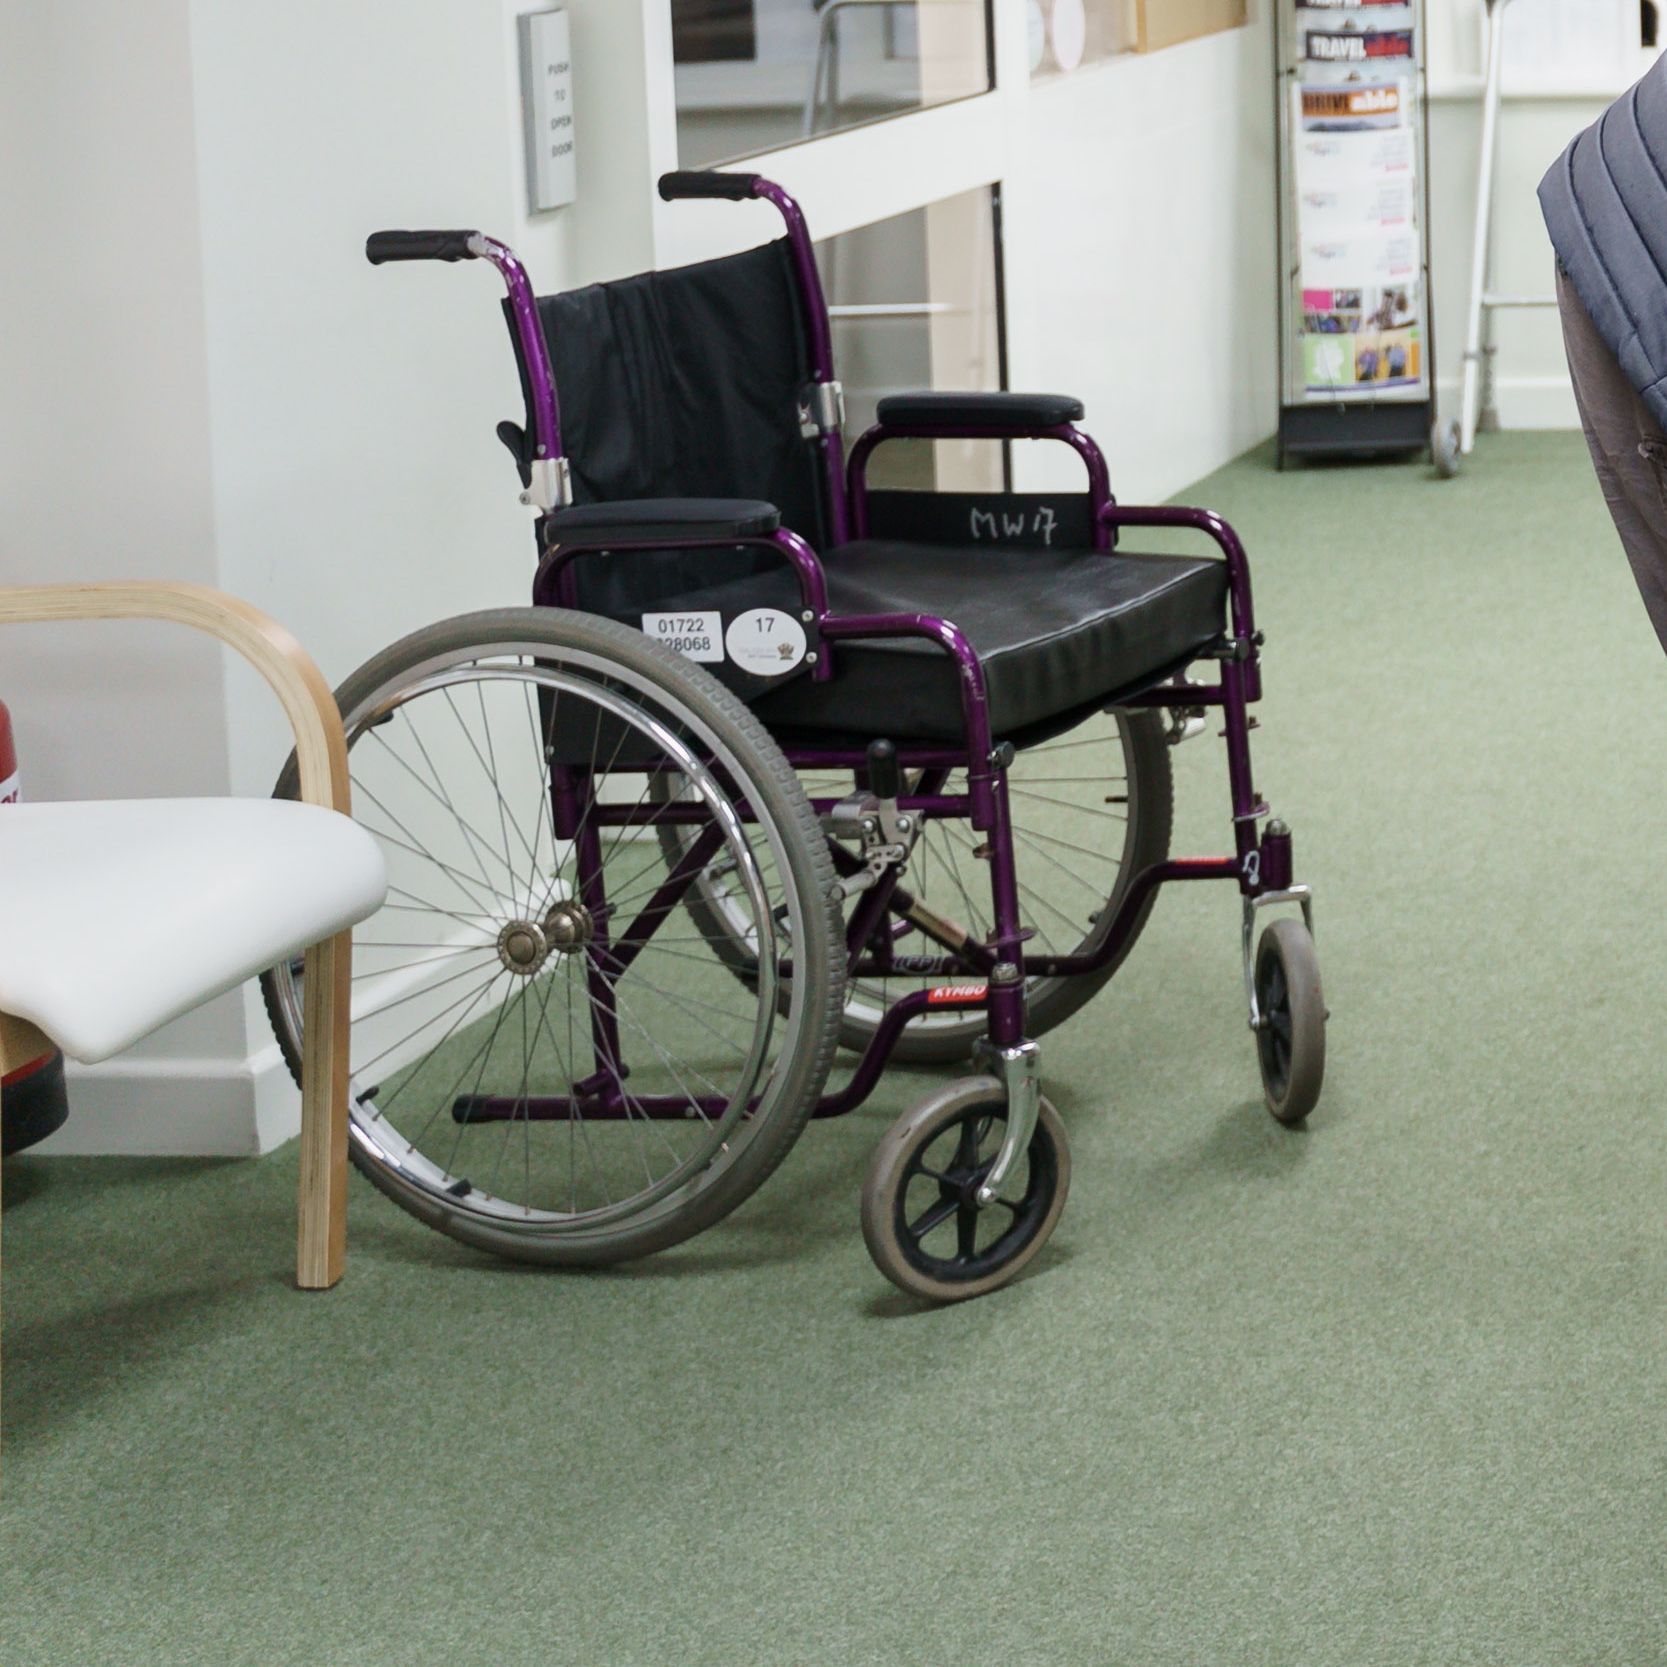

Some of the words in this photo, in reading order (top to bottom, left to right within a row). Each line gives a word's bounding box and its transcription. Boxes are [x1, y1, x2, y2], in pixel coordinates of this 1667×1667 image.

[550, 115, 573, 131] OPEN
[551, 140, 574, 159] DOOR
[657, 617, 705, 634] 01722
[756, 617, 775, 633] 17
